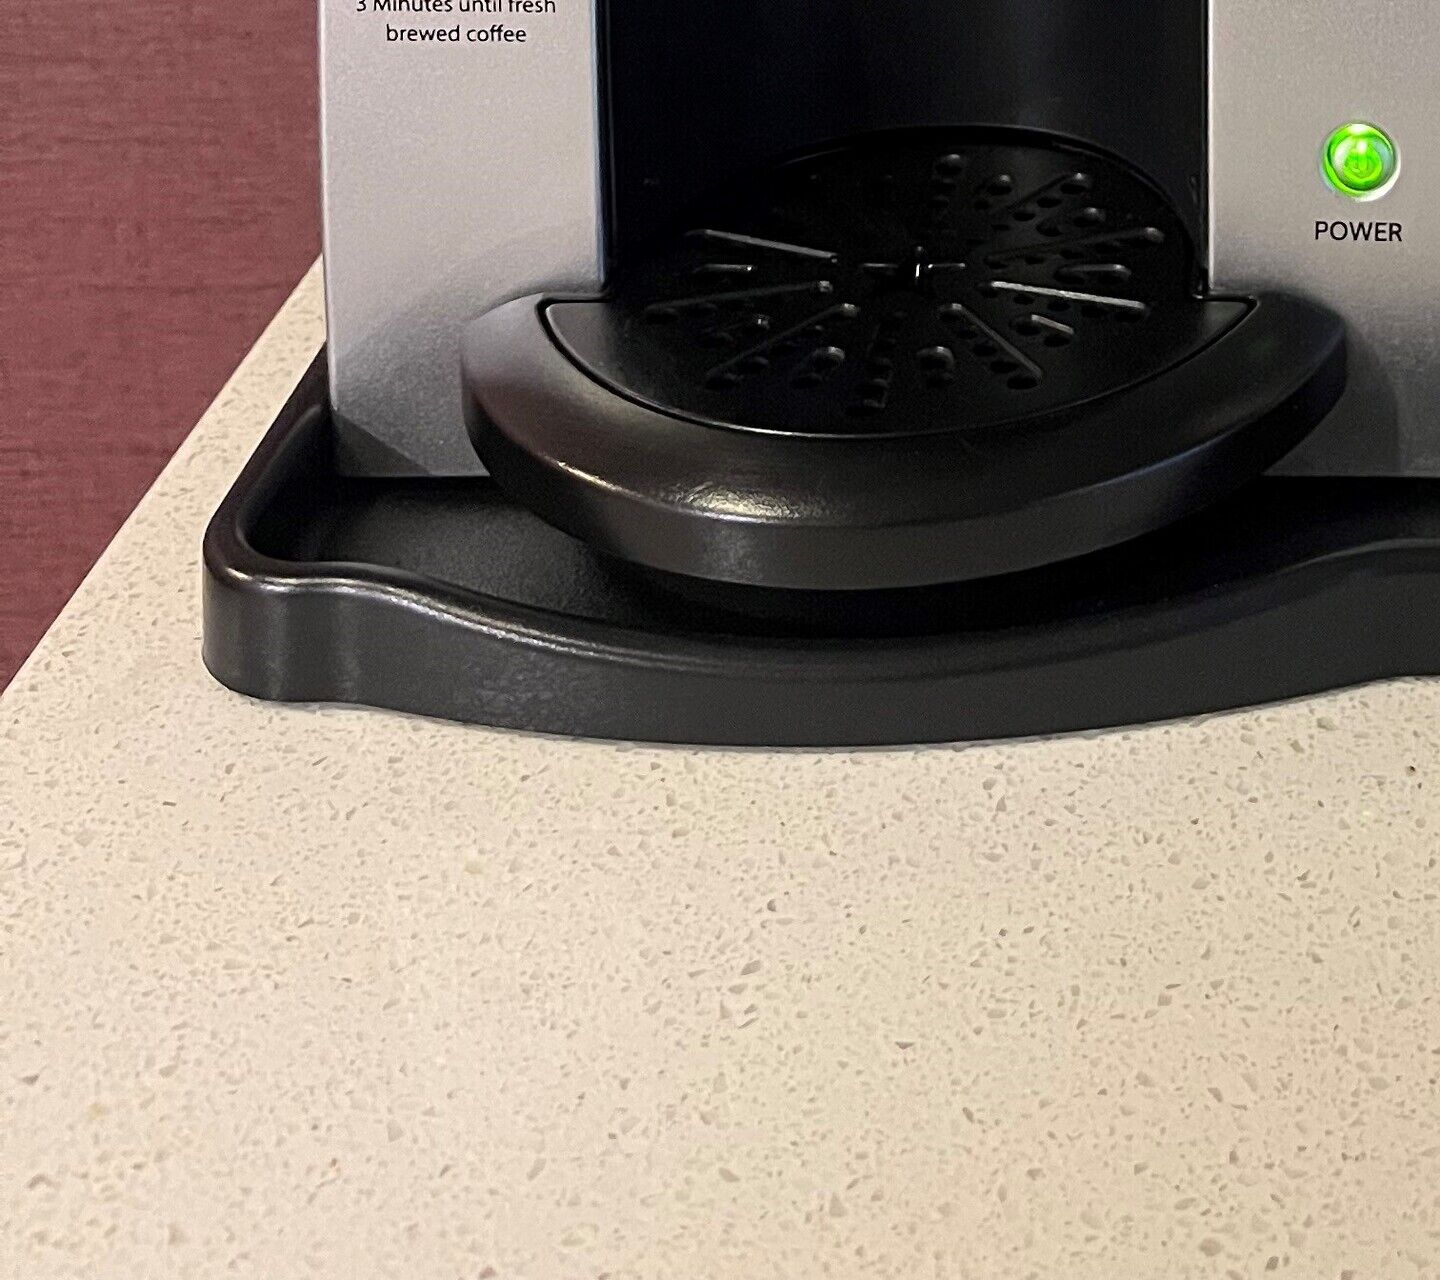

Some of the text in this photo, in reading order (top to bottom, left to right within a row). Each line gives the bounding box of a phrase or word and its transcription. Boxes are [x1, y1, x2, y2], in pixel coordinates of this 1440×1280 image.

[386, 23, 527, 42] brewed coffee
[1314, 220, 1403, 242] POWER
